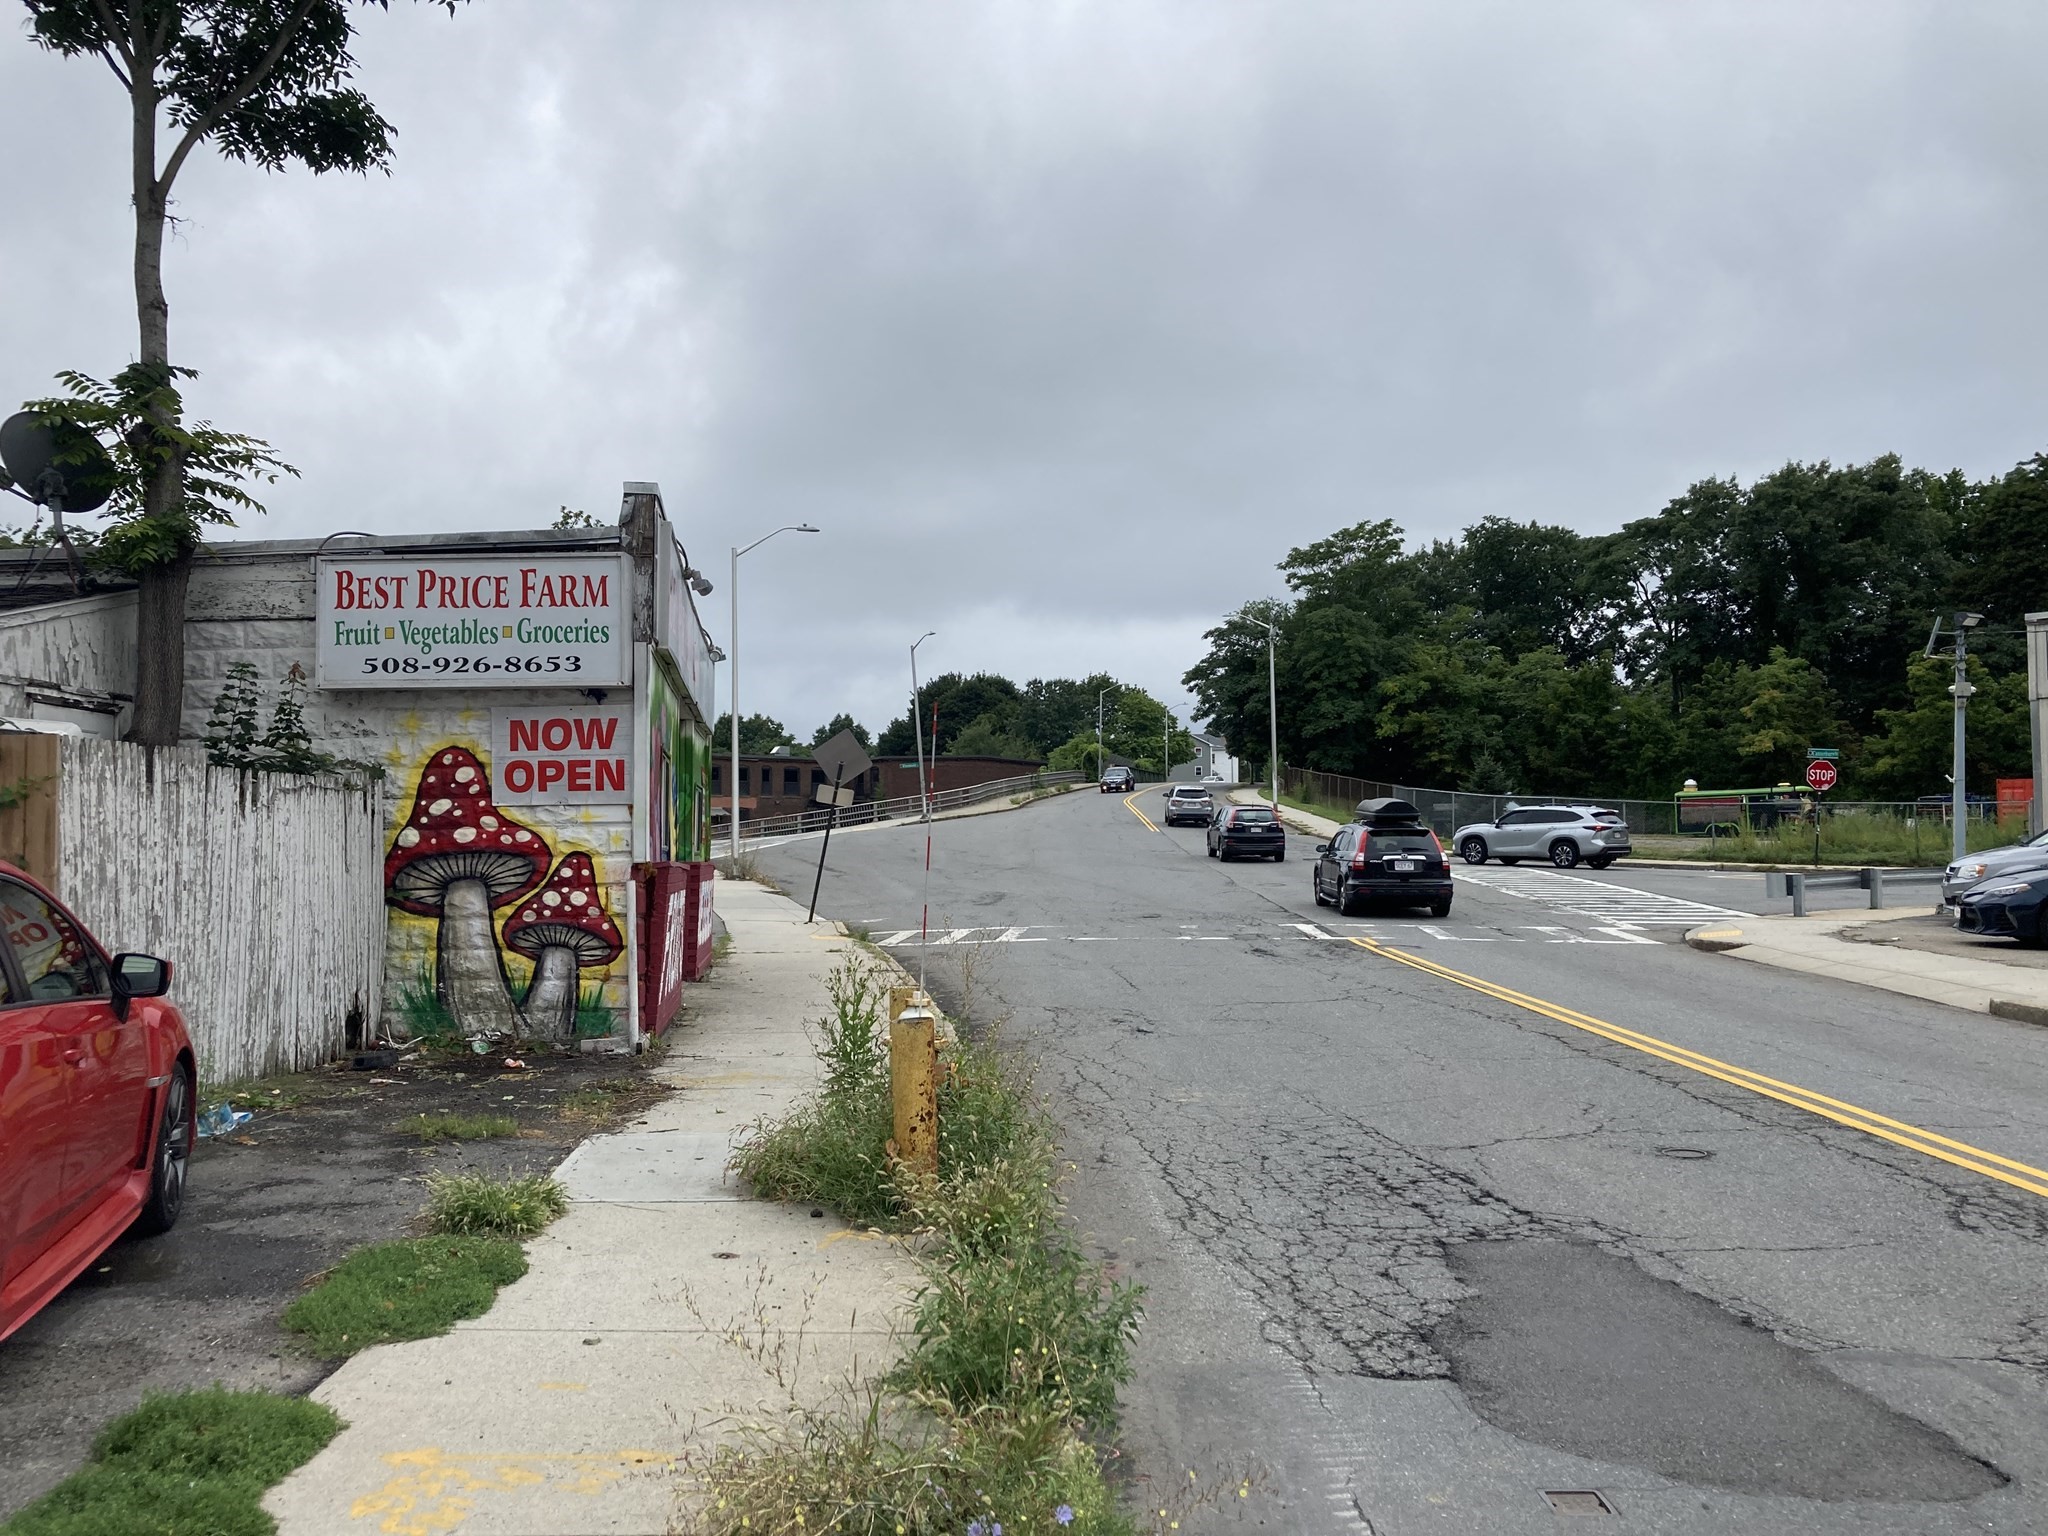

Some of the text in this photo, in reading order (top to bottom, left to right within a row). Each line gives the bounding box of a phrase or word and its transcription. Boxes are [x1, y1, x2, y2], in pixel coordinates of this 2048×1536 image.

[335, 568, 610, 610] BEST PRICE FARM
[334, 617, 610, 655] Fruit Vegetables Groceries
[361, 655, 582, 674] 508-926-8653
[509, 717, 619, 752] NOW
[503, 758, 625, 793] OPEN
[1809, 769, 1834, 781] STOP
